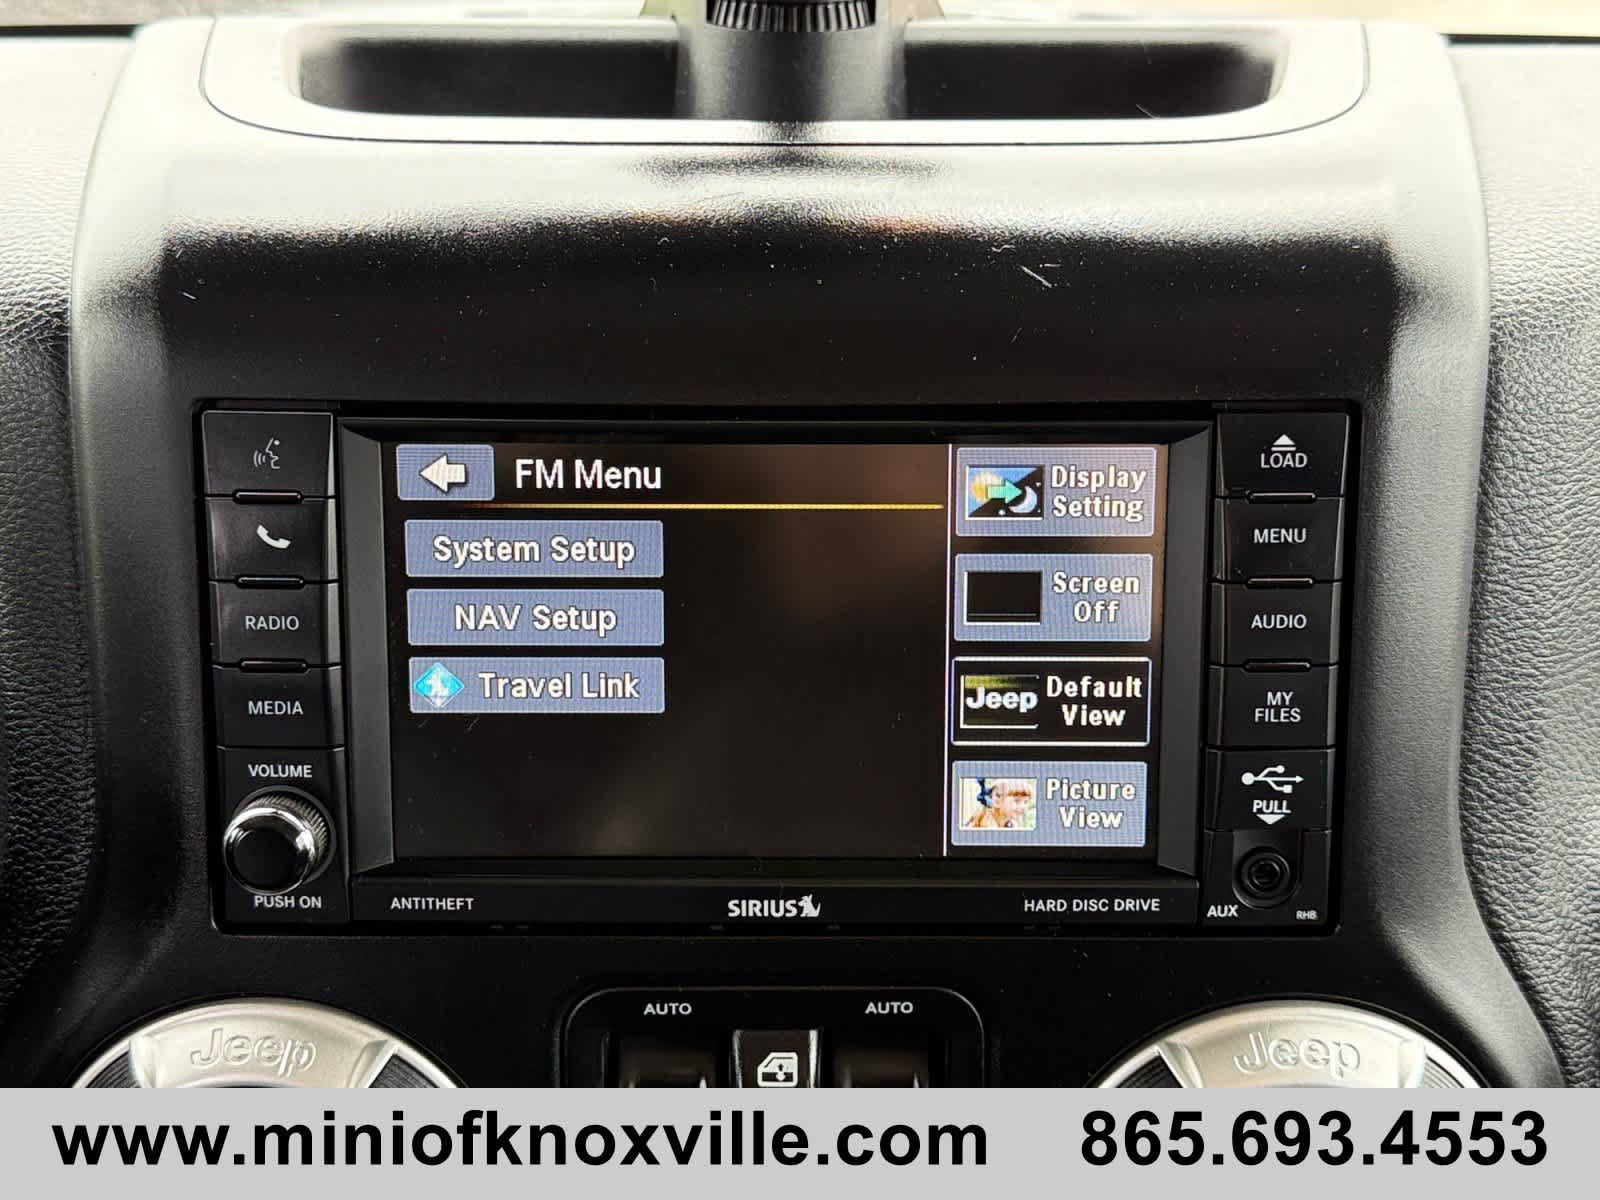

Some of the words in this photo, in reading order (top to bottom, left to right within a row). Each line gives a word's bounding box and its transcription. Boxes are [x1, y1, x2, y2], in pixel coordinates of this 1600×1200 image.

[1260, 452, 1308, 468] LOAD
[515, 459, 564, 489] FM
[575, 459, 662, 489] Menu
[1051, 465, 1146, 492] Display
[1053, 494, 1144, 522] Setting
[1254, 528, 1307, 544] MENU
[433, 535, 541, 569] System
[551, 535, 635, 569] Setup
[1053, 572, 1140, 594] Screen
[455, 605, 520, 631] NAV
[532, 605, 617, 637] Setup
[1073, 601, 1120, 622] Off
[245, 615, 299, 631] RADIO
[1251, 614, 1307, 629] AUDIO
[479, 673, 572, 698] Travel
[581, 673, 640, 698] Link
[1046, 676, 1142, 698] Default
[247, 700, 304, 715] MEDIA
[966, 688, 1038, 712] Jeep
[1266, 691, 1293, 707] MY
[1062, 704, 1126, 726] View
[1254, 707, 1301, 722] FILES
[248, 764, 312, 778] VOLUME
[1045, 778, 1135, 800] Picture
[1252, 799, 1291, 814] PULL
[1060, 806, 1123, 828] View
[254, 895, 295, 908] PUSH
[298, 895, 322, 908] ON
[390, 897, 474, 911] ANTITHEFT
[728, 899, 799, 918] SIRIUS
[1024, 898, 1067, 913] HARD
[1072, 898, 1109, 912] DISC
[1114, 898, 1160, 912] DRIVE
[1207, 905, 1238, 918] AUX
[643, 1002, 692, 1016] AUTO
[864, 999, 913, 1016] AUTO
[191, 1027, 318, 1078] Jeep
[1235, 1030, 1362, 1079] Jeep
